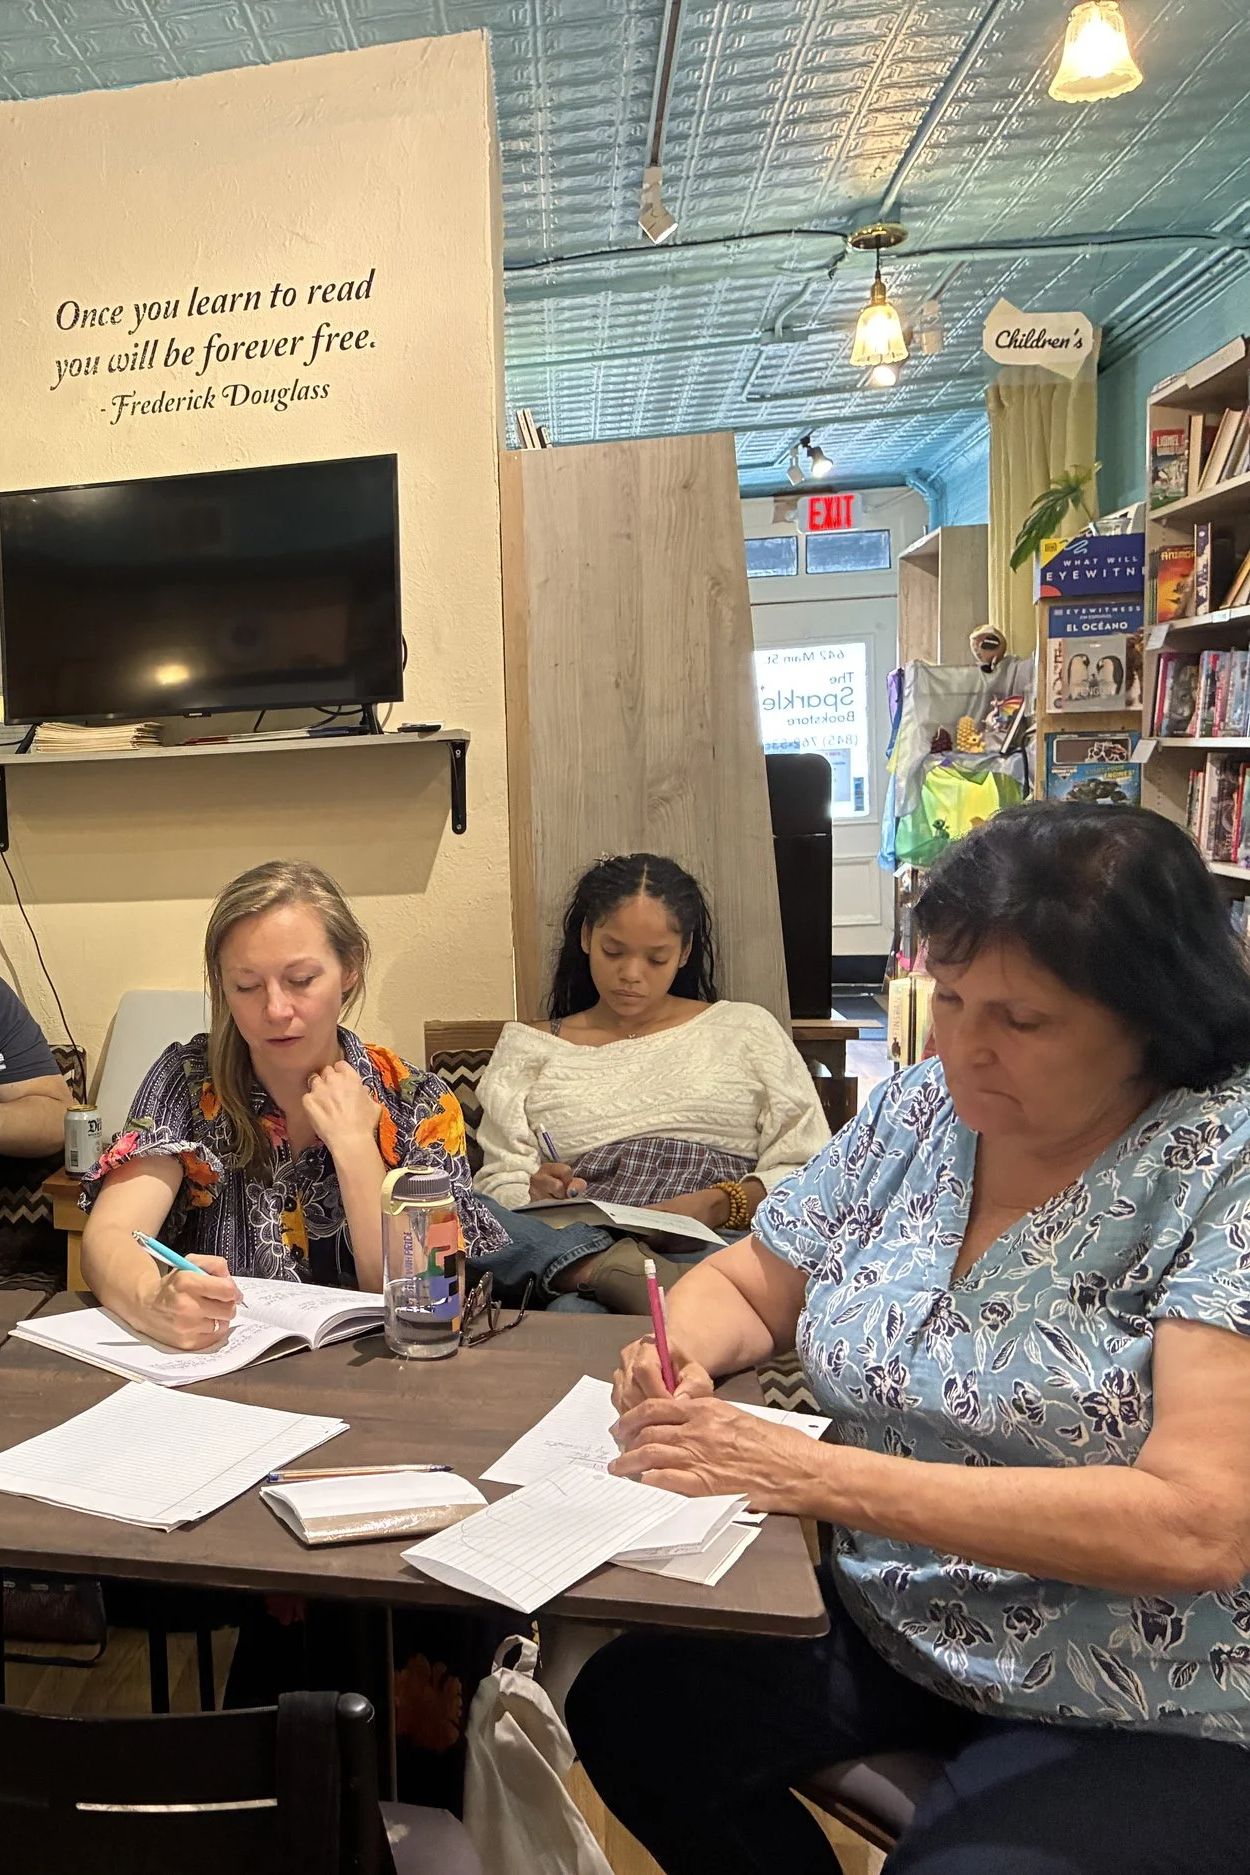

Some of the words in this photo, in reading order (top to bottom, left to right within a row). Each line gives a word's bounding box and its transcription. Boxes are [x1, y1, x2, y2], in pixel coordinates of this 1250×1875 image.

[56, 300, 124, 331] Once
[128, 298, 180, 335] you
[187, 286, 262, 317] learn
[270, 283, 297, 309] to
[307, 268, 376, 305] read
[995, 328, 1083, 349] Children's
[50, 354, 100, 391] you
[108, 339, 159, 374] will
[164, 337, 194, 368] be
[195, 333, 304, 377] forever
[303, 322, 376, 366] free.
[221, 379, 330, 412] Douglass
[808, 494, 855, 531] EXIT
[1063, 558, 1098, 567] WHAT
[1107, 556, 1138, 564] WILL
[1066, 605, 1142, 616] EYEWITNESS
[1066, 624, 1078, 632] EL
[1082, 621, 1128, 632] OCÉANO
